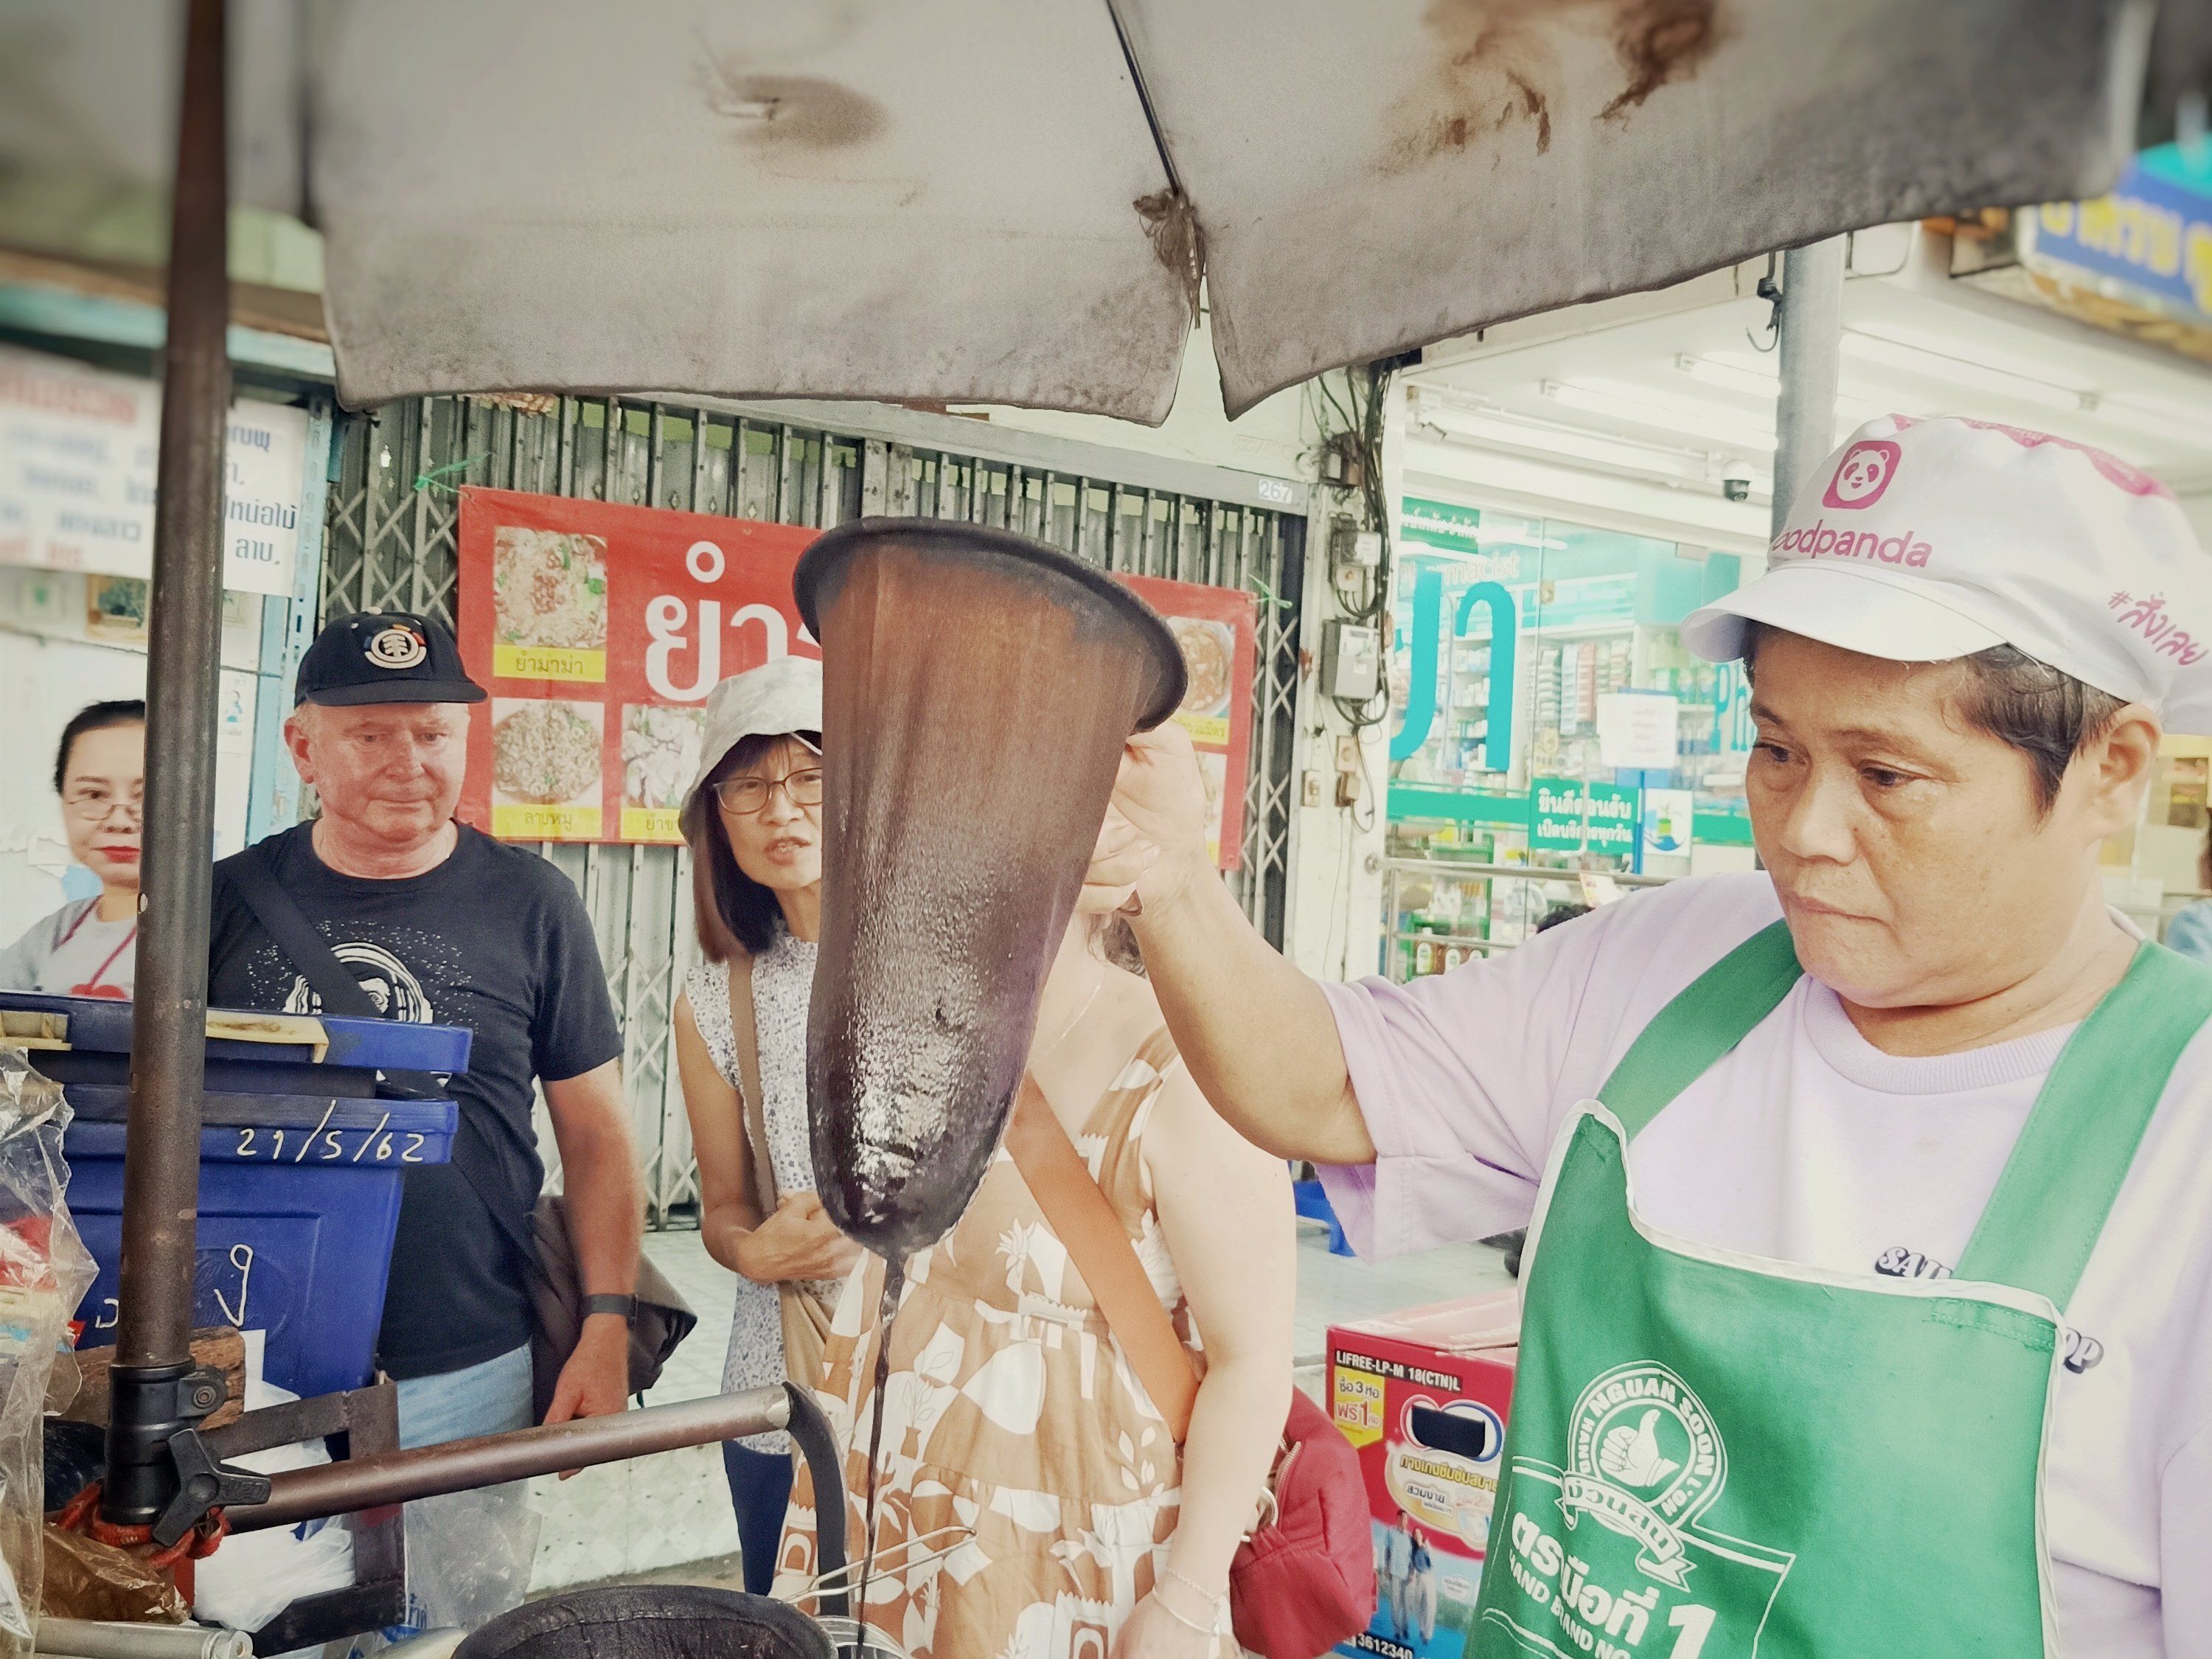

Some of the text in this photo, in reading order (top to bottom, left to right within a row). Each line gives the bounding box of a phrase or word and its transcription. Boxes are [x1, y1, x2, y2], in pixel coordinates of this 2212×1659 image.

[1259, 479, 1291, 502] 267
[1772, 518, 1933, 568] oodpanda
[1399, 550, 1520, 589] Pmacist
[645, 540, 823, 702] ยำ
[515, 650, 584, 675] ยำมาม่า
[524, 811, 573, 832] ลาบหมู
[645, 815, 680, 832] ยำข
[1336, 1350, 1405, 1379] LIFREE-LP-M
[1355, 1380, 1364, 1394] 3
[1337, 1402, 1357, 1422] ฟรี
[1360, 1399, 1369, 1427] 1
[1578, 1377, 1716, 1517] HAND NGUAN SOON NO.1
[1512, 1512, 1717, 1659] ตรมือที่ 1
